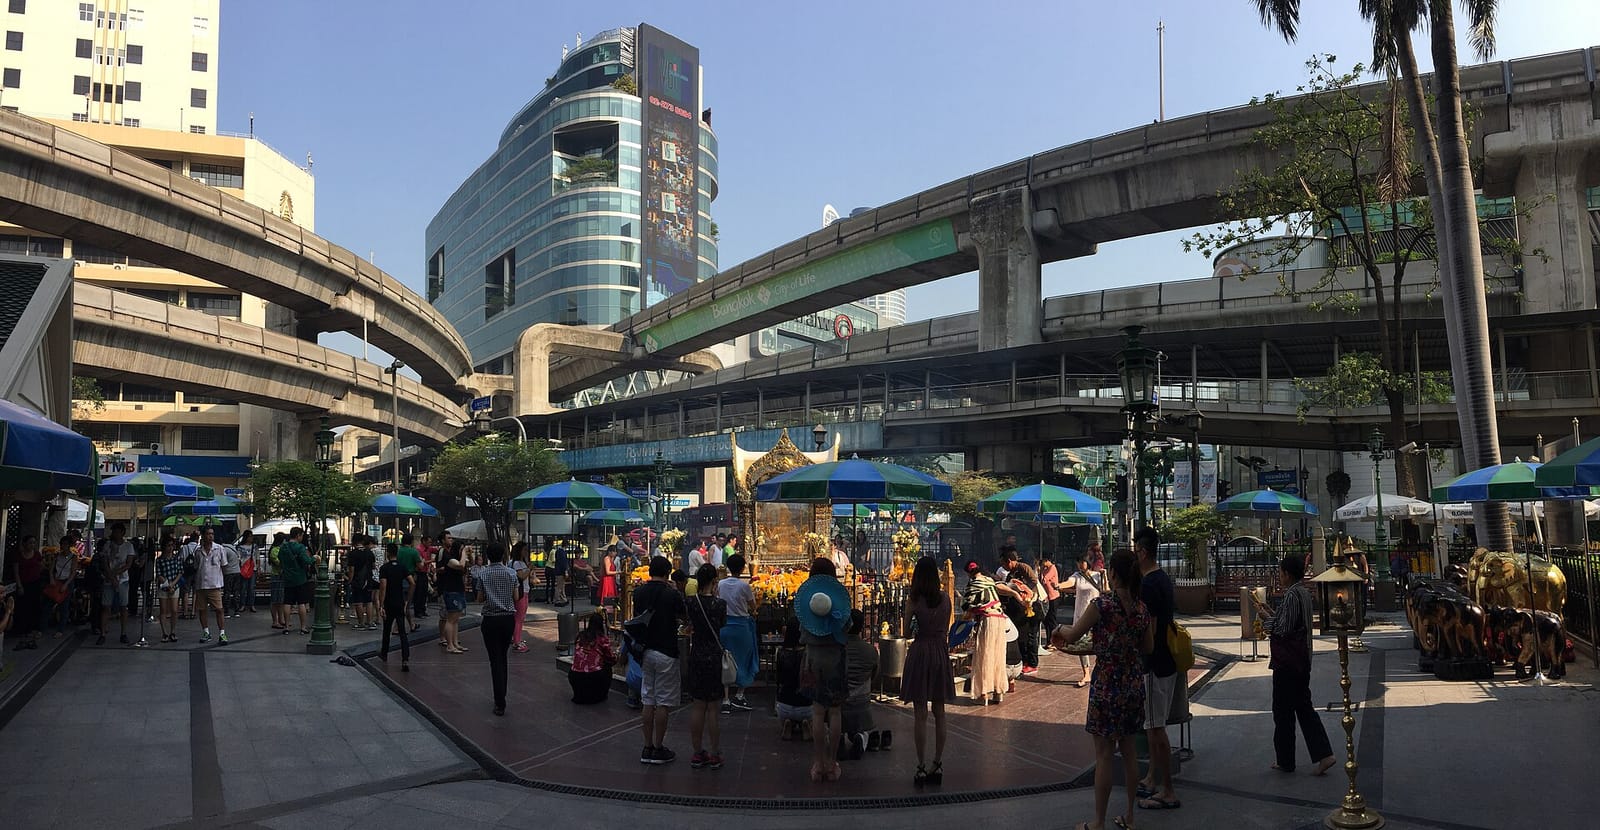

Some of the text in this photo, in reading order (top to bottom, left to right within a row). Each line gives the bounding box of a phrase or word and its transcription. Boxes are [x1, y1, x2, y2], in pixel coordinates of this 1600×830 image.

[711, 290, 757, 319] Bangkok
[799, 273, 816, 286] Life
[103, 461, 136, 473] TMB
